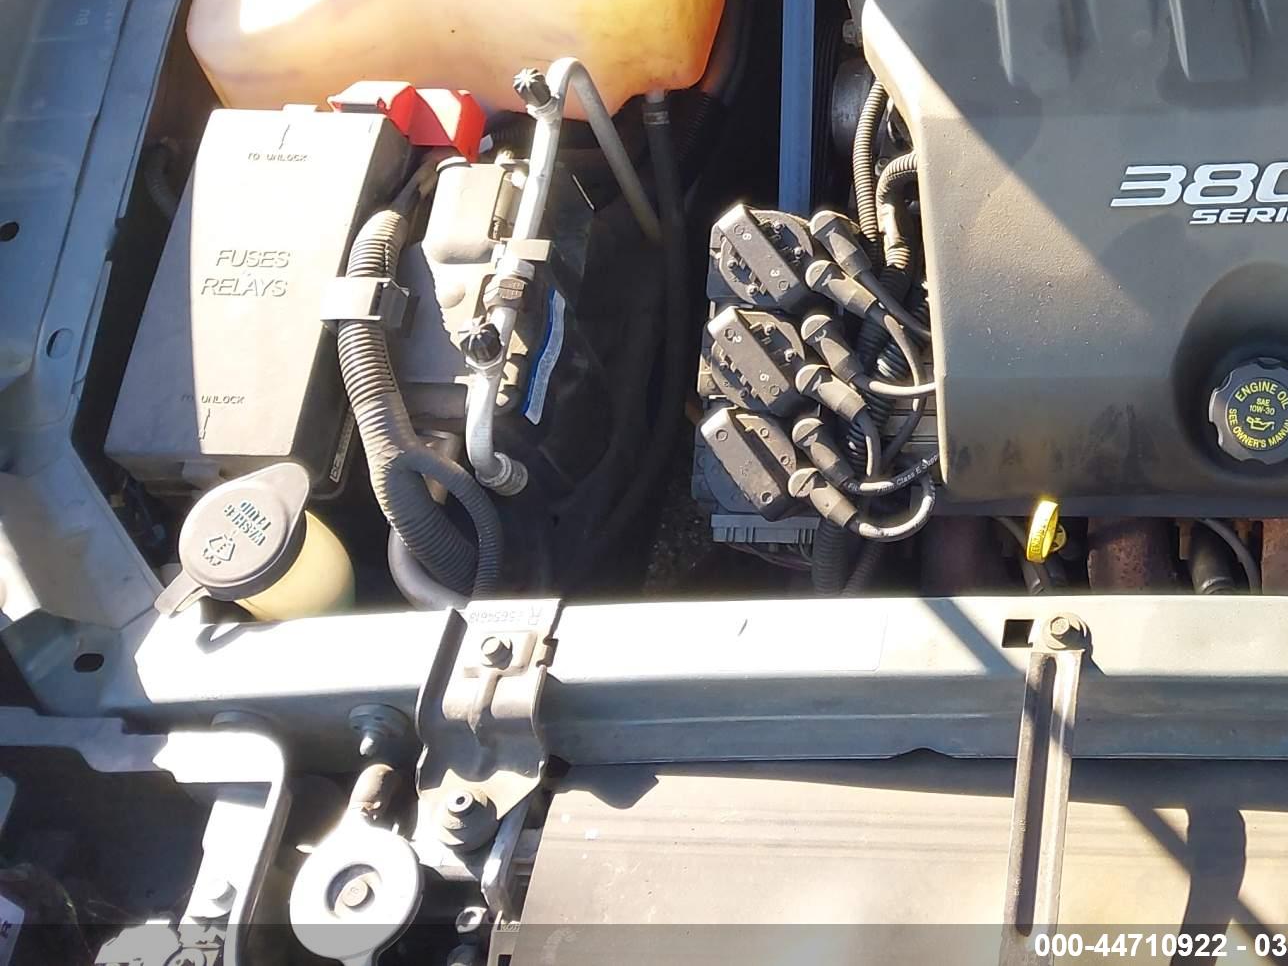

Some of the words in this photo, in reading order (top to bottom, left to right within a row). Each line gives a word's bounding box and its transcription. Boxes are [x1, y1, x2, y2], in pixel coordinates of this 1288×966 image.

[216, 250, 291, 268] FUSES
[201, 278, 288, 297] RELAYS
[201, 394, 245, 404] UNLOCK
[1235, 381, 1278, 402] ENGINE
[1249, 404, 1276, 416] 10W-30
[1256, 398, 1270, 406] SAE
[1228, 408, 1238, 426] SEE
[1233, 426, 1267, 448] OWNER'S
